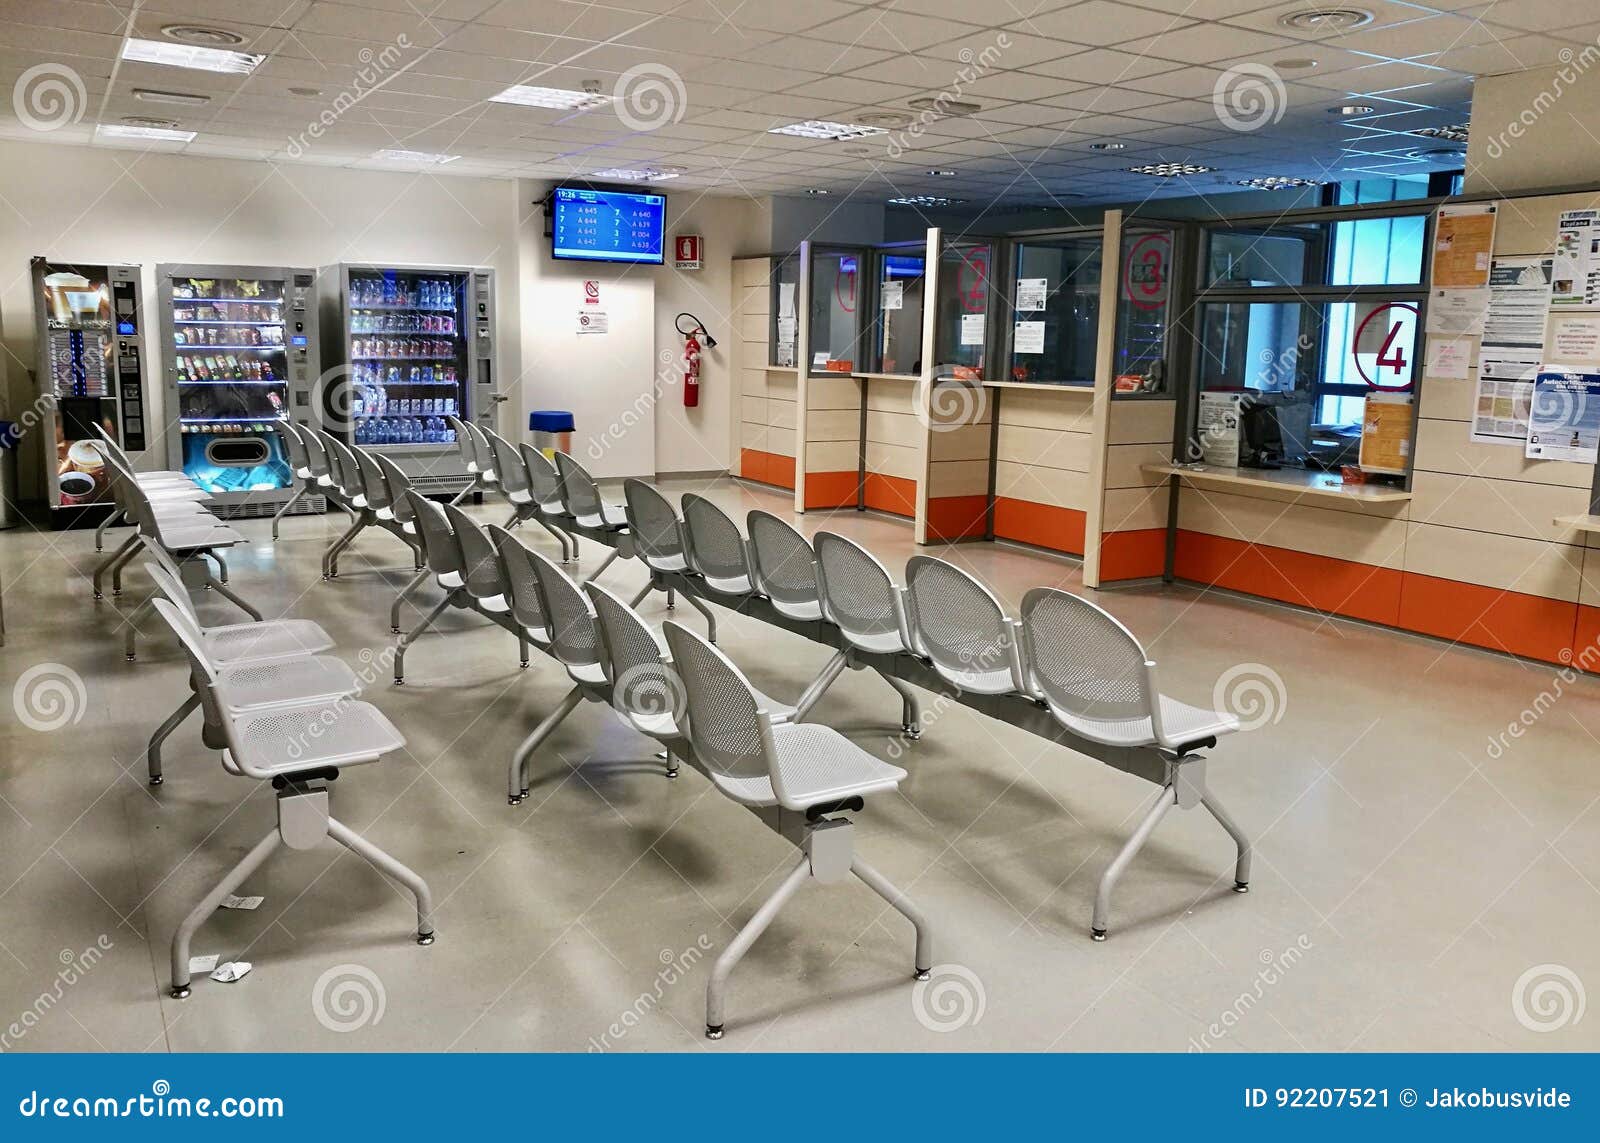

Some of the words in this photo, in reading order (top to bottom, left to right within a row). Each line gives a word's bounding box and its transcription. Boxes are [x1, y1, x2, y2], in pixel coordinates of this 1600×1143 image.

[558, 191, 576, 199] 19:26
[968, 259, 986, 298] 2
[1140, 250, 1162, 296] 3
[1376, 321, 1407, 375] 4
